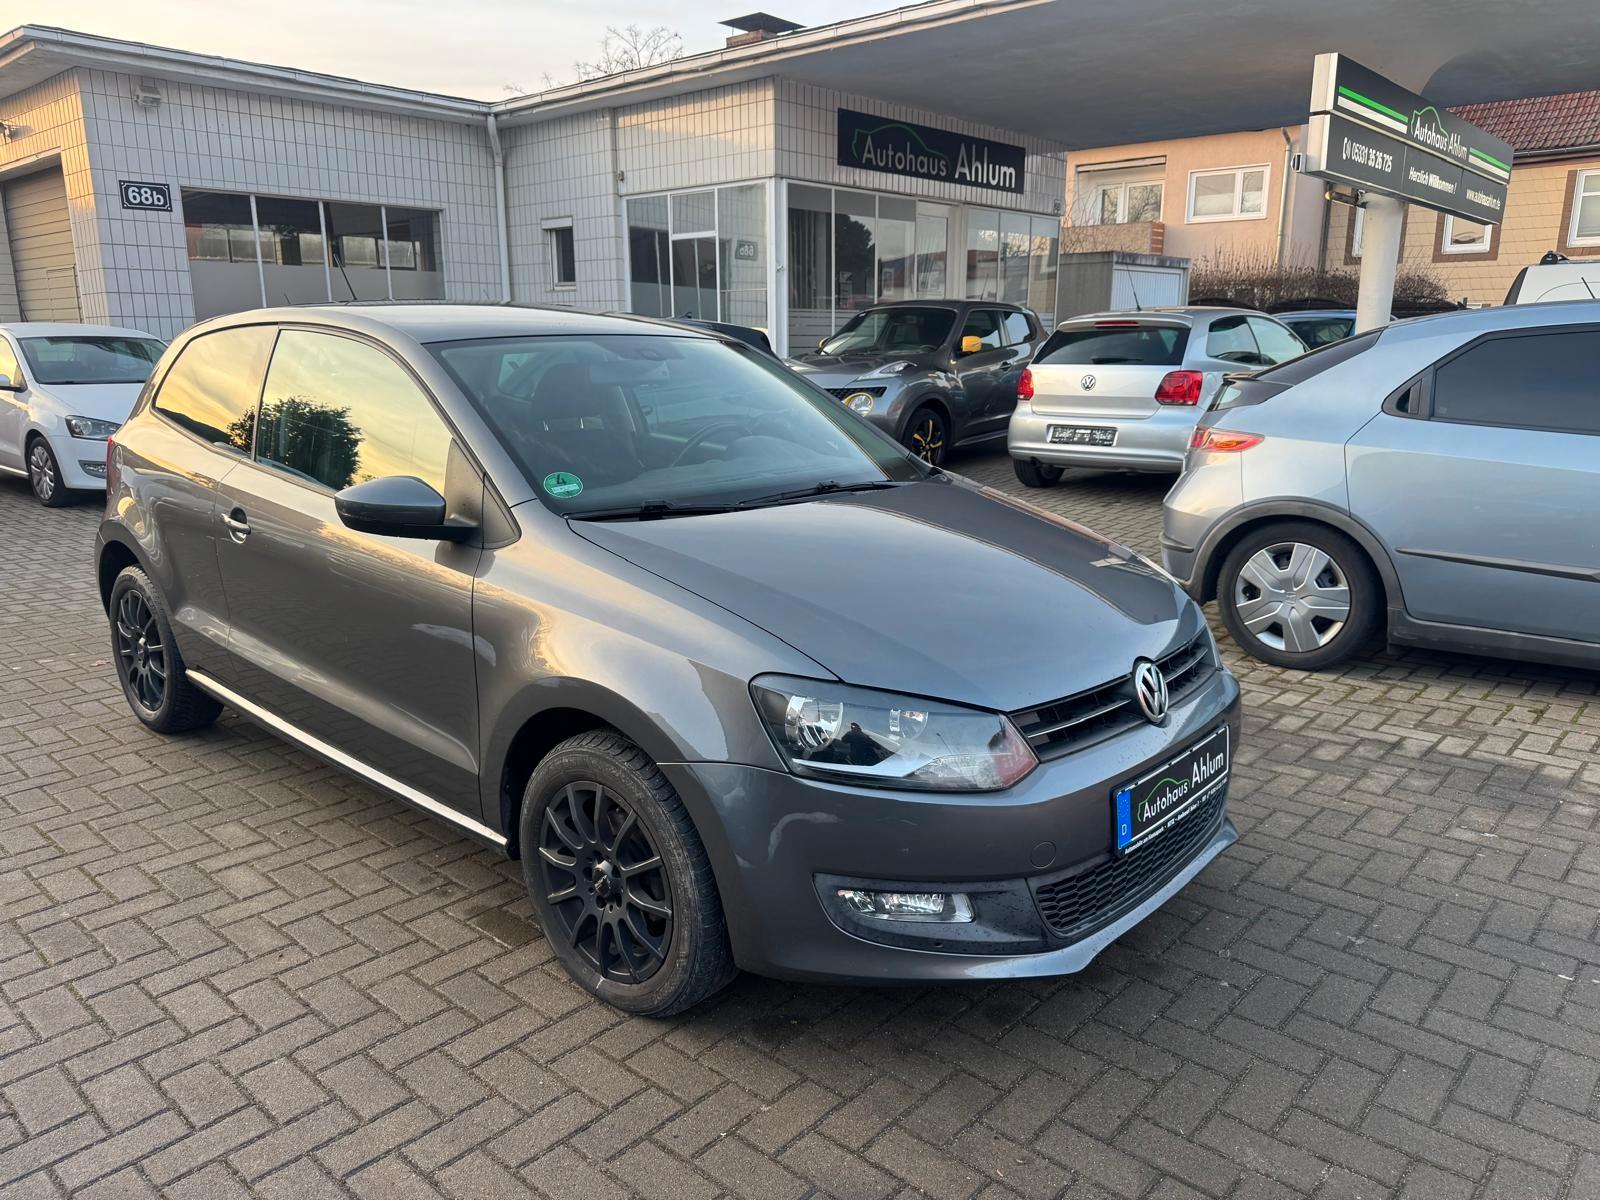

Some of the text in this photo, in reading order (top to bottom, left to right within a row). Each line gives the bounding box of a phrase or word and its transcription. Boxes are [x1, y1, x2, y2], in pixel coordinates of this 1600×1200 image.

[1413, 116, 1467, 160] Autohaus Ahlum
[862, 135, 1016, 188] Autohaus Ahlum
[1351, 142, 1368, 165] 05331
[128, 186, 164, 205] 68b
[556, 473, 567, 485] 4
[1143, 782, 1188, 822] Autohaus
[1191, 752, 1224, 788] Ahlum
[1121, 823, 1127, 836] D
